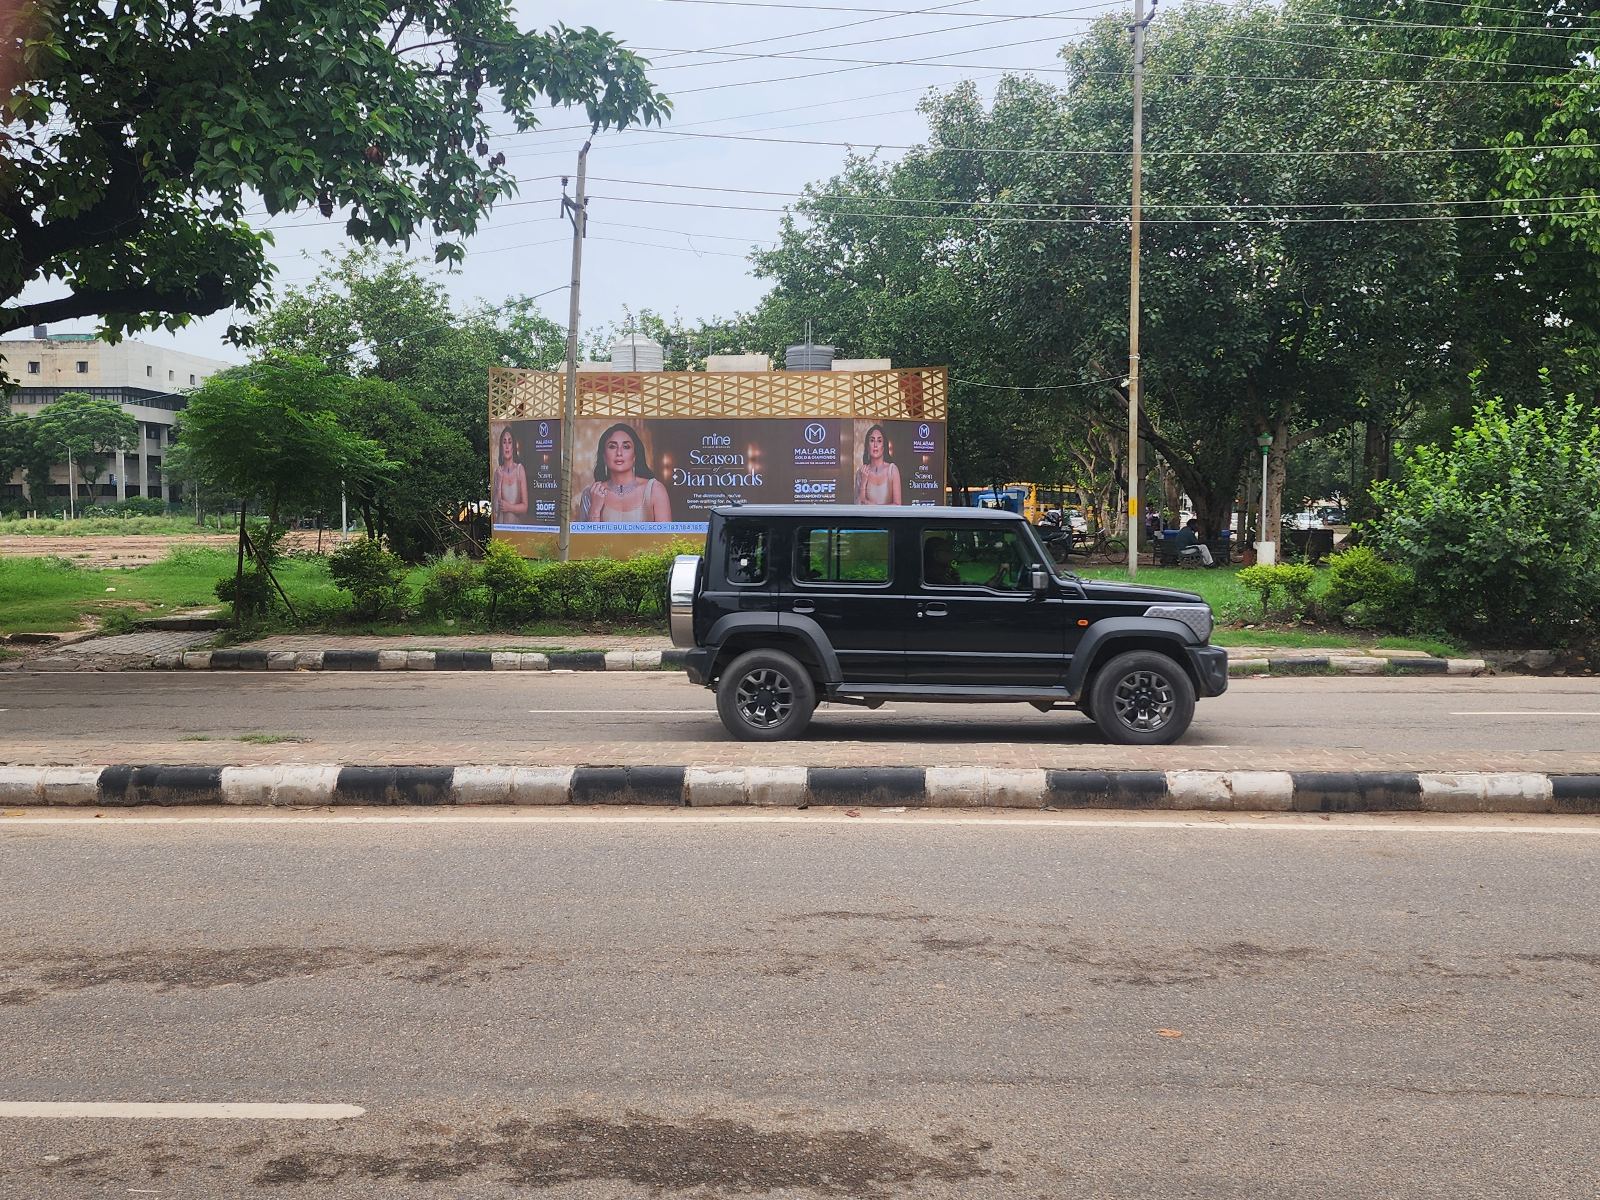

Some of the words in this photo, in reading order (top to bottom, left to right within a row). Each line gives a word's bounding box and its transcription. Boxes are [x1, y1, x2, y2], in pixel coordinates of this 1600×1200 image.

[702, 433, 731, 446] mine
[690, 449, 744, 465] Season
[712, 465, 722, 473] of
[672, 468, 763, 487] Diamonds
